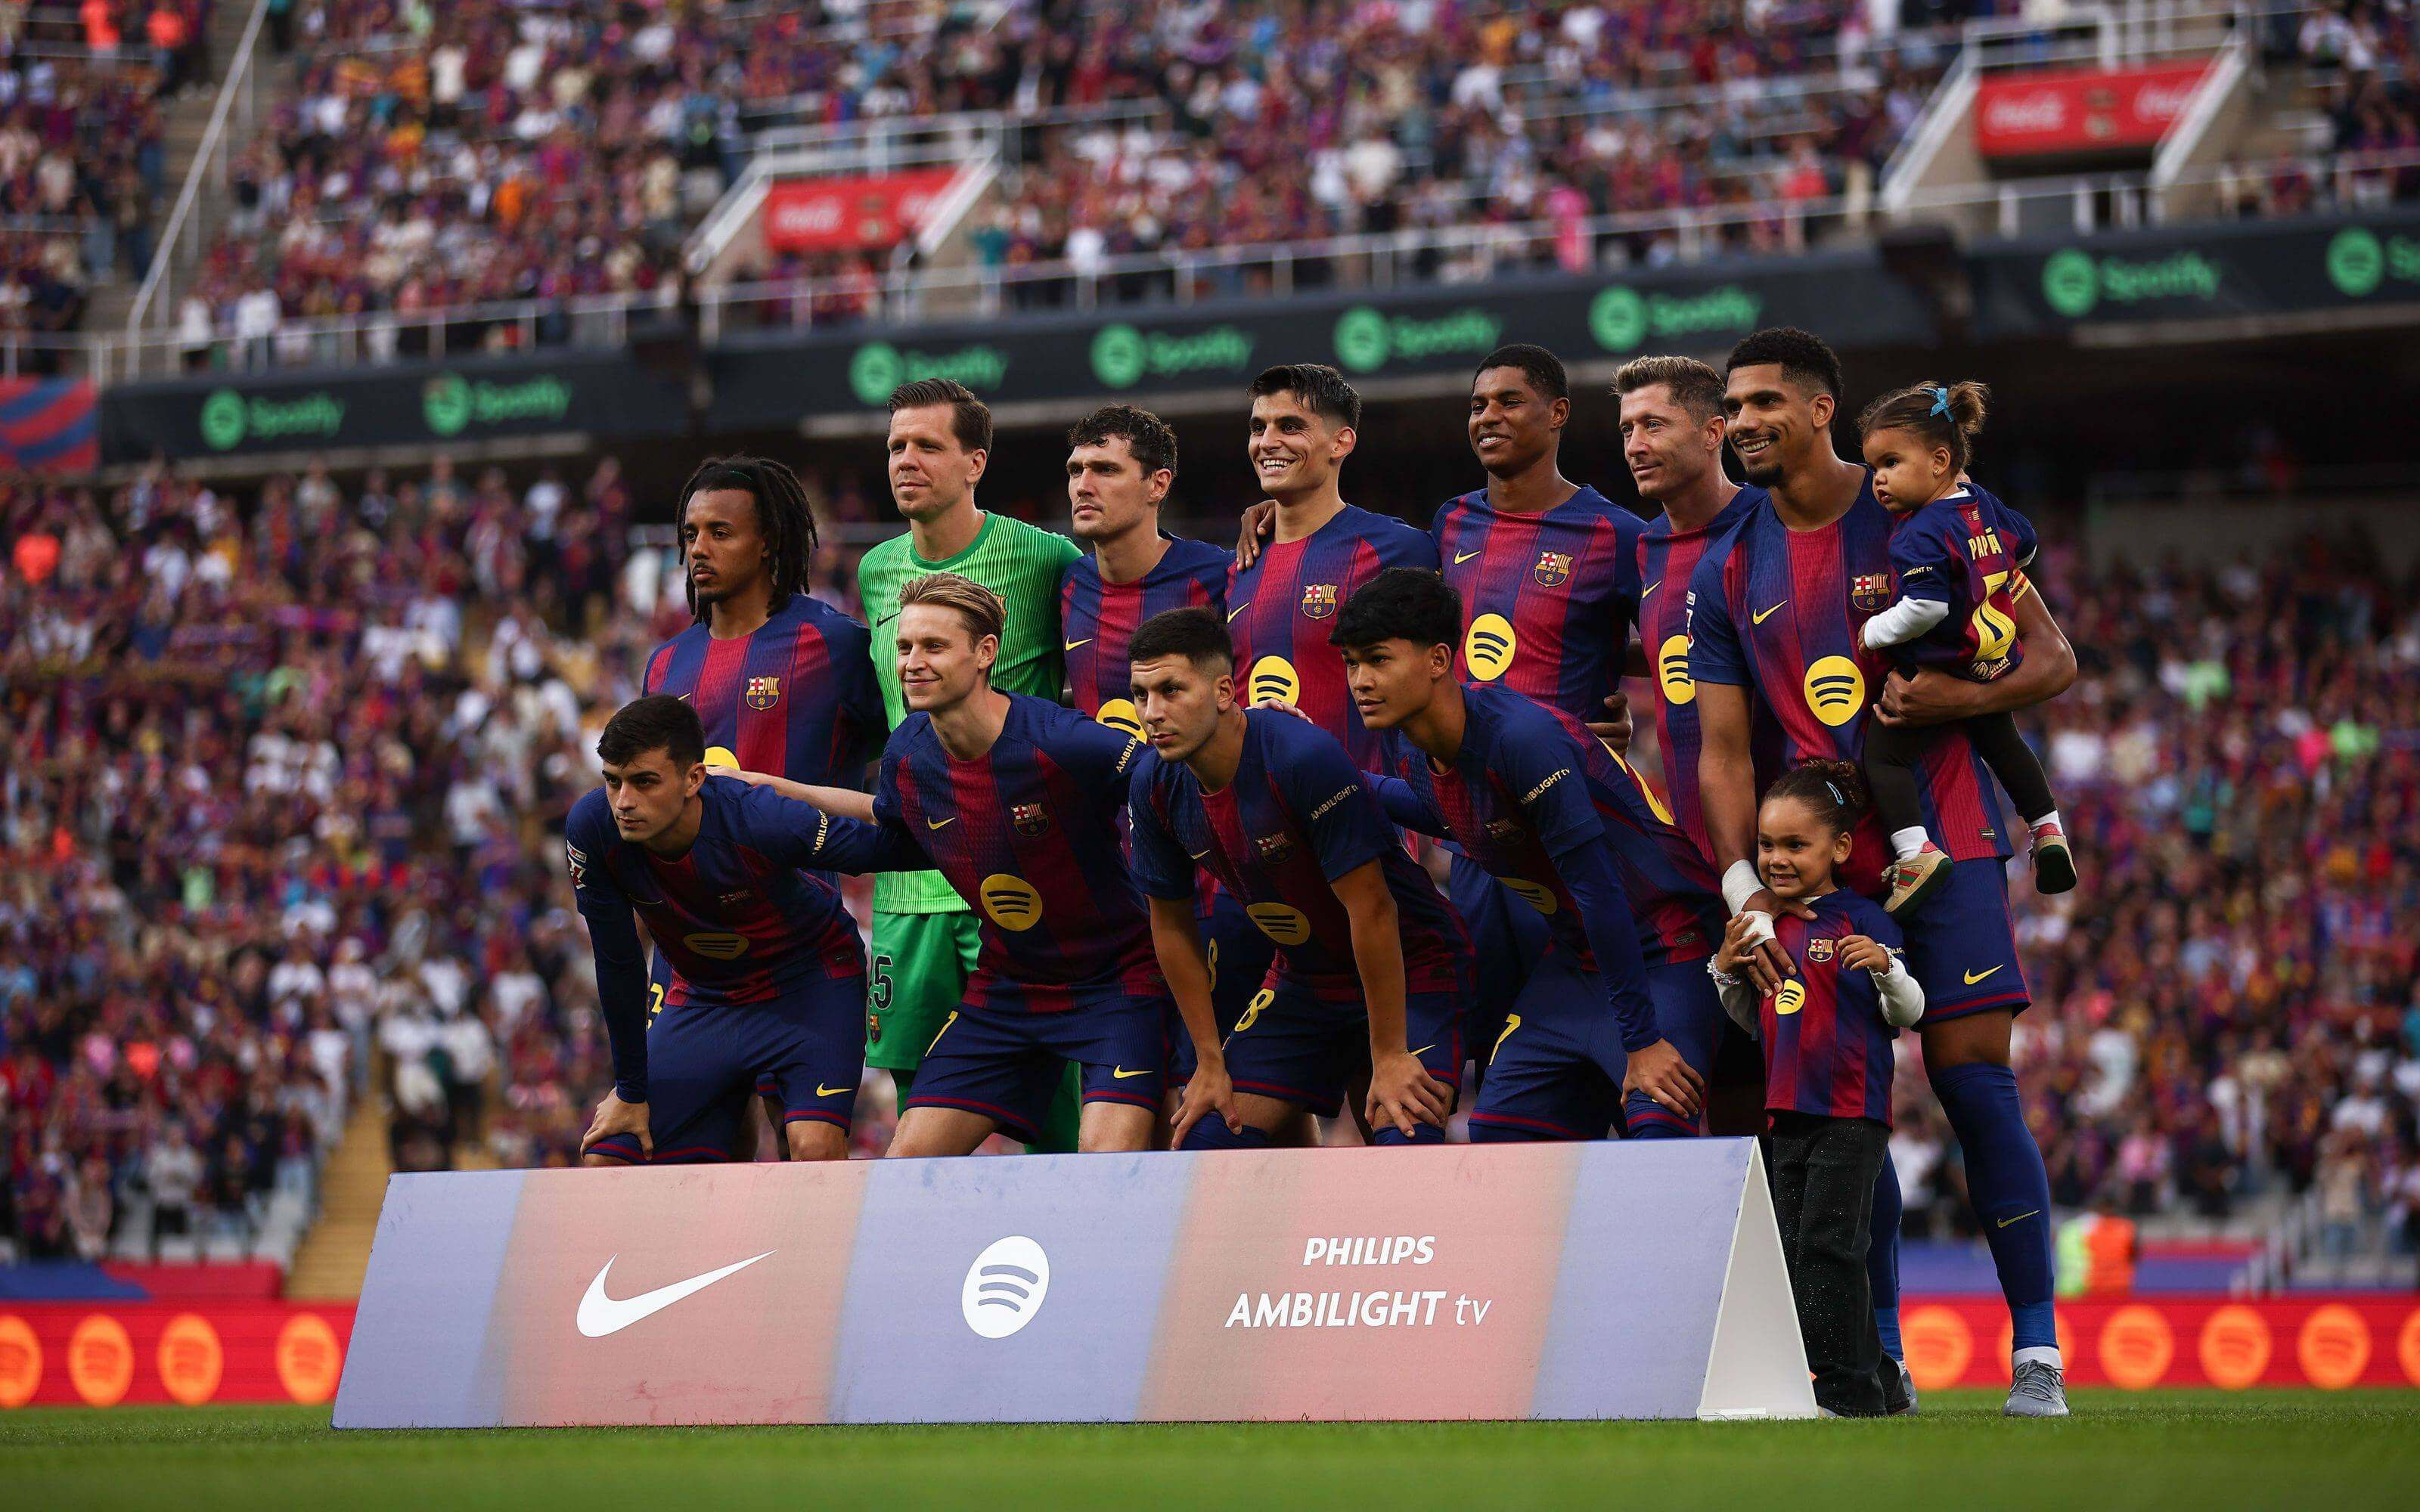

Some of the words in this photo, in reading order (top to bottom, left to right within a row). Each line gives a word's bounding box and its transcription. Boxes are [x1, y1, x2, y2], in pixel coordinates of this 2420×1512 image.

[869, 954, 893, 1011] 5
[1302, 1236, 1435, 1266] PHILIPS
[1224, 1290, 1447, 1328] AMBILIGHT
[1454, 1294, 1491, 1325] tv
